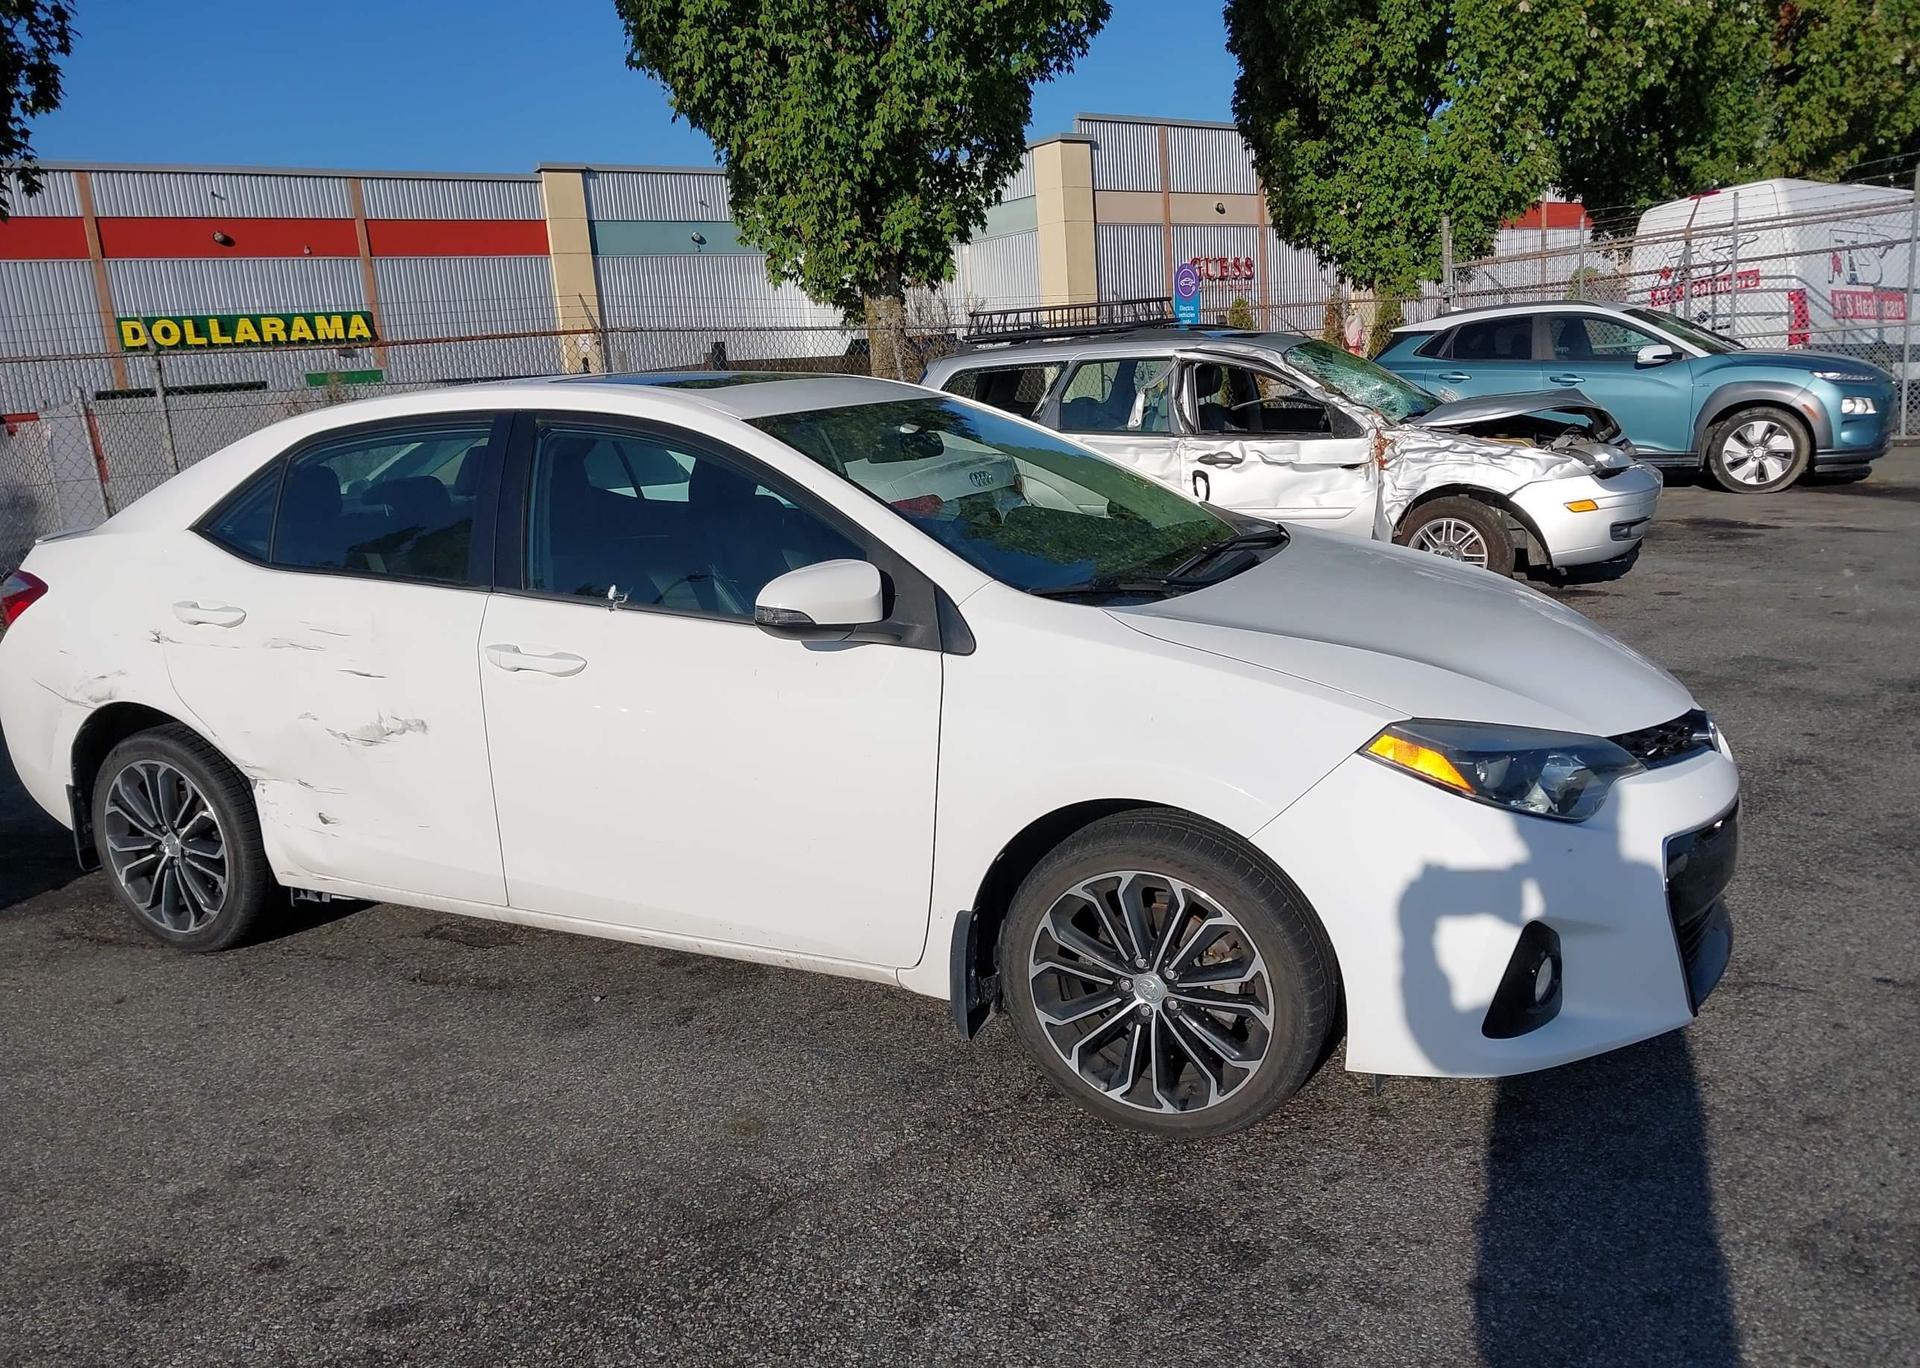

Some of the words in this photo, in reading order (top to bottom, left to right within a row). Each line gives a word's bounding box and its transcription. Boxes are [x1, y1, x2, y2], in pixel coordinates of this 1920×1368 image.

[1190, 256, 1254, 280] GUESS
[1682, 274, 1757, 296] ealhcre
[1855, 294, 1905, 318] Healcare
[121, 315, 372, 347] DOLLARAMA
